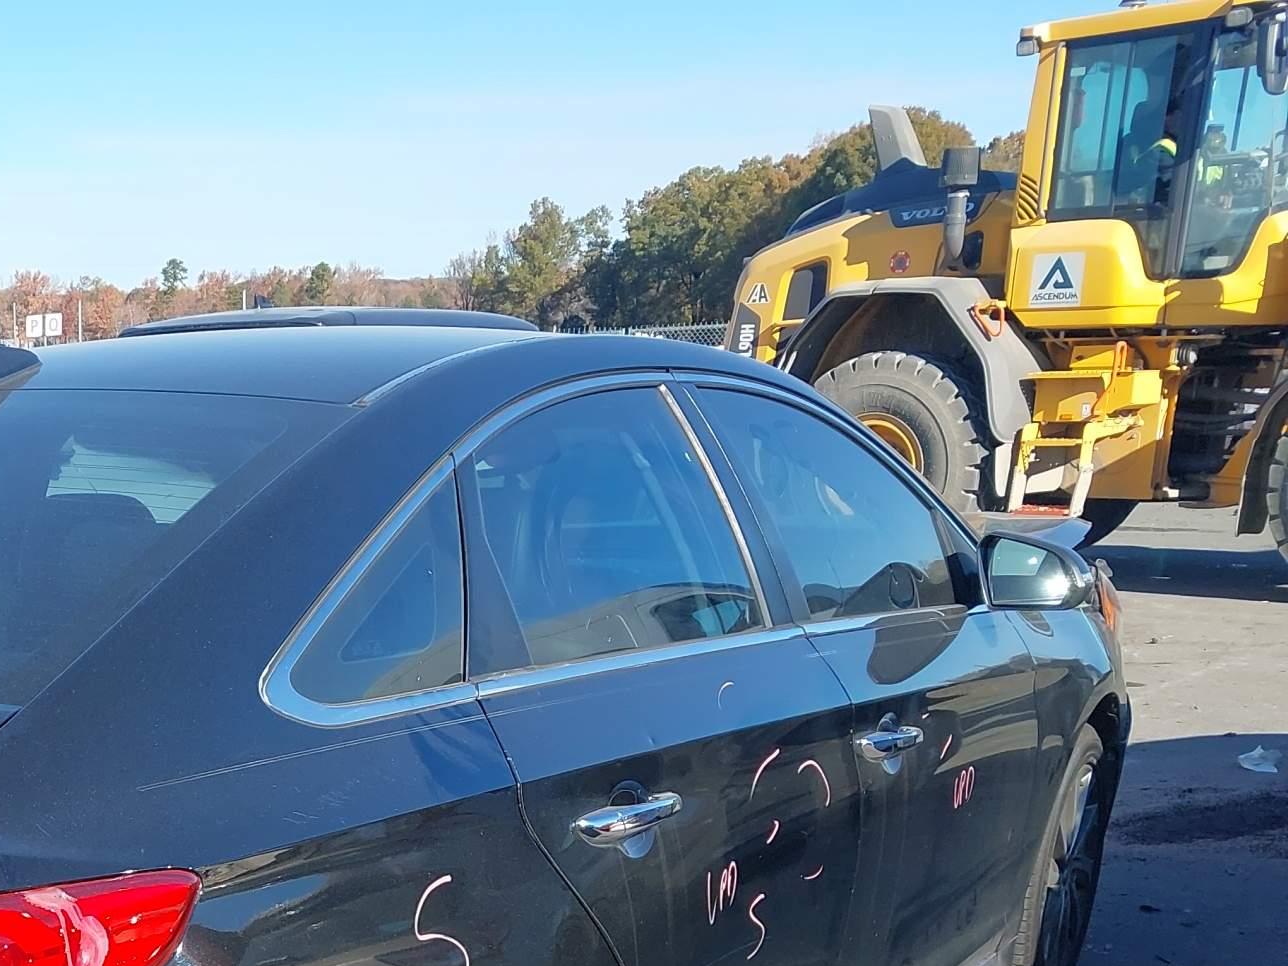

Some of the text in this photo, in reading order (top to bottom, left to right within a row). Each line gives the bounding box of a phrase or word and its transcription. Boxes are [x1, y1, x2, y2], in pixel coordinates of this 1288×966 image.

[900, 202, 976, 220] VOLO
[1031, 292, 1079, 302] ASCENDUM
[30, 319, 40, 334] P
